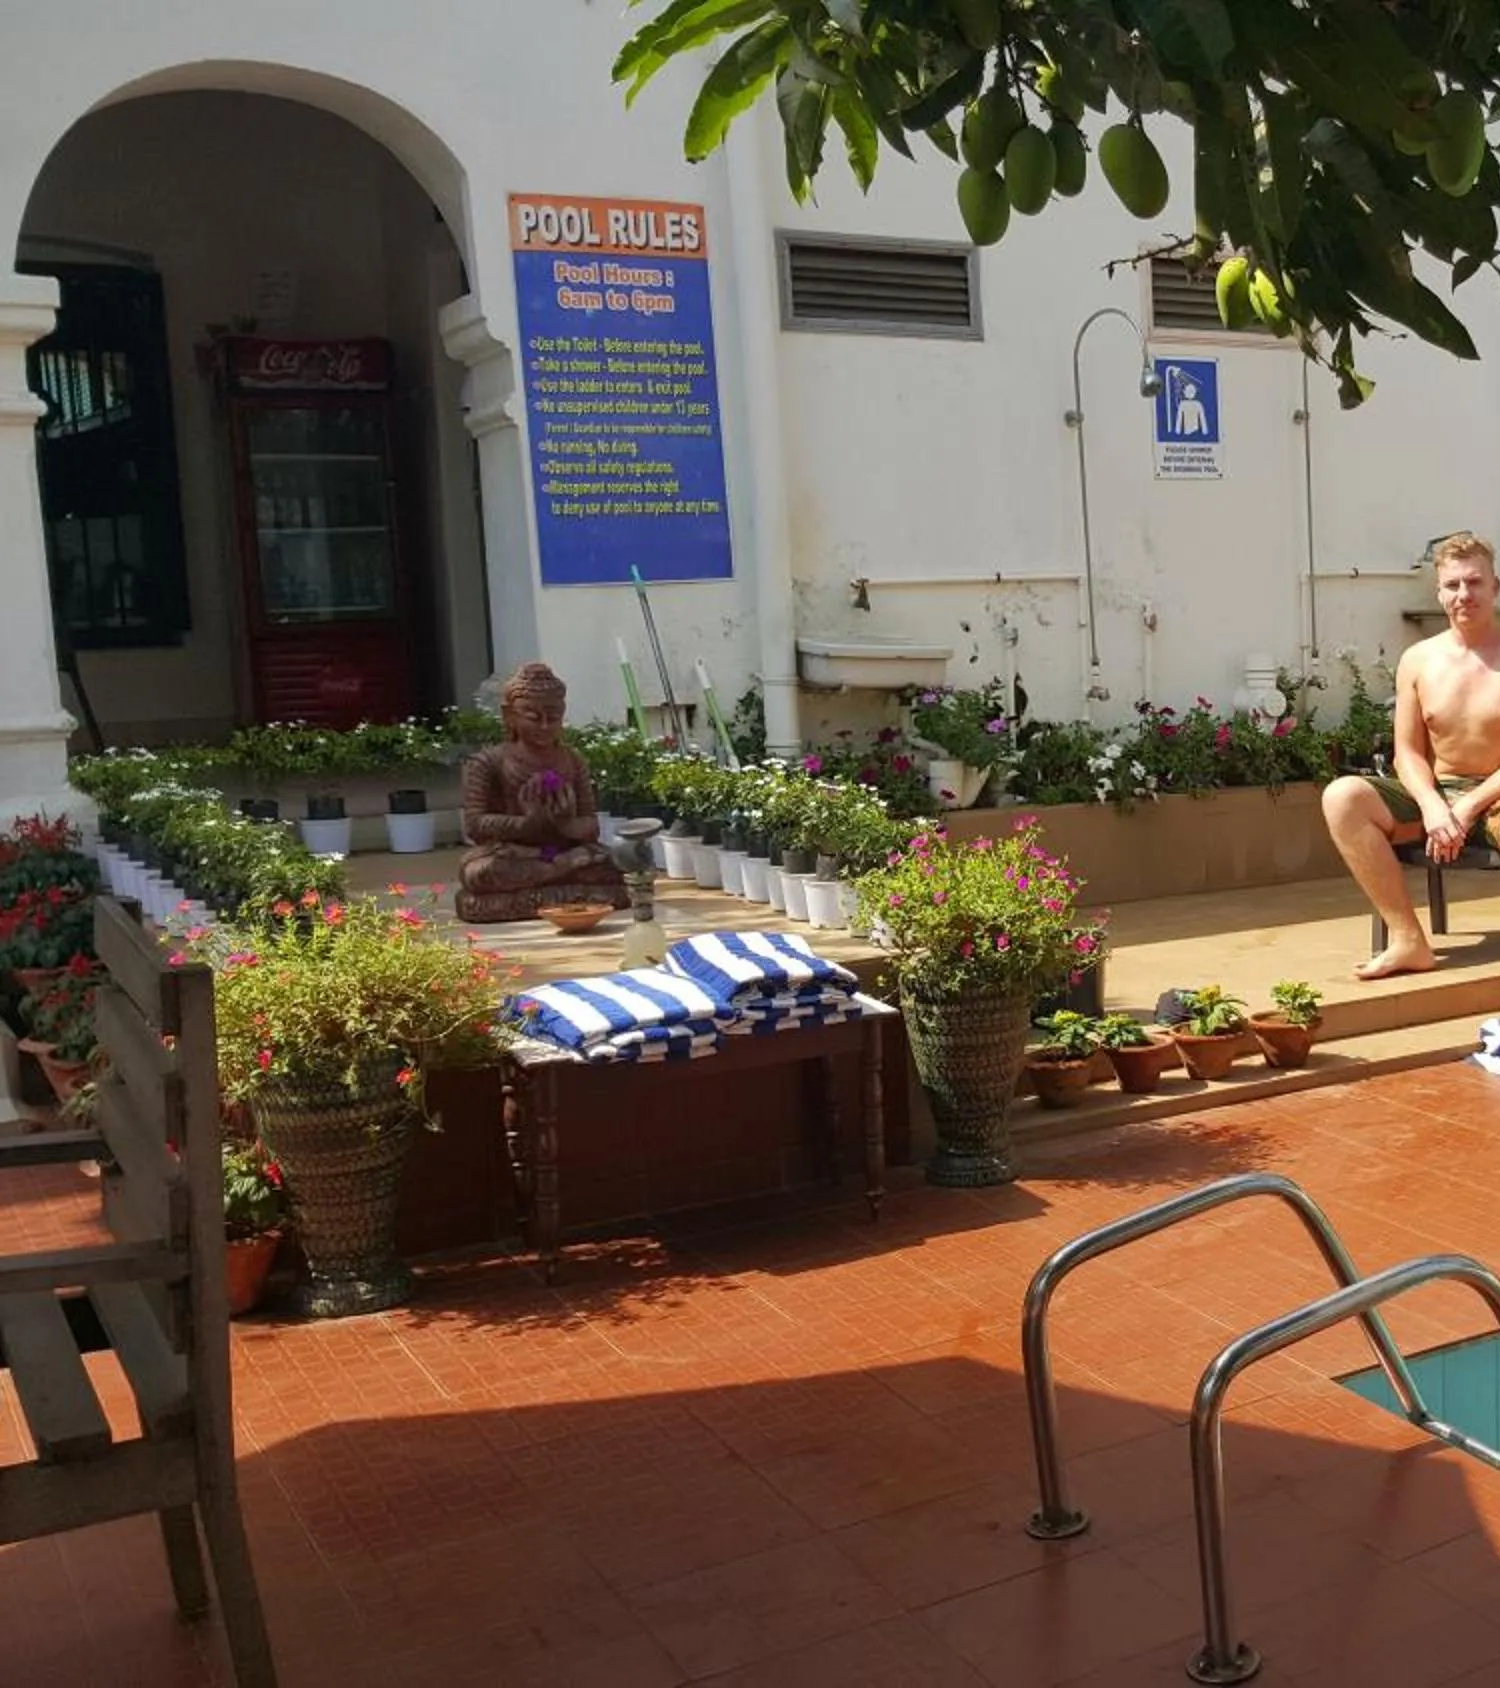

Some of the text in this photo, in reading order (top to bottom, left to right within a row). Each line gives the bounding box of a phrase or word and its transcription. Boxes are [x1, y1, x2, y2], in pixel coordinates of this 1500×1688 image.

[518, 203, 700, 250] POOL RULES
[554, 260, 599, 284] Pool
[603, 263, 662, 286] Hours
[557, 286, 675, 315] 6am to 6pm
[537, 337, 554, 352] Use
[556, 338, 570, 352] the
[572, 337, 597, 352] Toilet
[604, 338, 632, 353] Before
[633, 340, 669, 357] entering
[670, 339, 683, 354] the
[259, 343, 363, 381] Cocaola
[540, 357, 560, 372] Take
[570, 359, 600, 373] shower
[608, 358, 635, 373] Before
[637, 360, 671, 377] entering
[673, 361, 686, 374] the
[541, 378, 558, 393] Use
[559, 379, 574, 392] the
[576, 379, 602, 392] ladder
[605, 380, 614, 393] to
[656, 381, 671, 395] exit
[545, 440, 558, 453] No
[598, 440, 610, 454] No
[586, 460, 597, 474] all
[599, 461, 625, 477] safety
[550, 481, 679, 497] Management reserves the right
[552, 501, 560, 514] to
[563, 501, 584, 518] deny
[586, 503, 601, 514] use
[603, 501, 614, 514] of
[615, 502, 633, 516] pool
[634, 502, 643, 514] to
[675, 502, 685, 514] at
[686, 503, 700, 517] any
